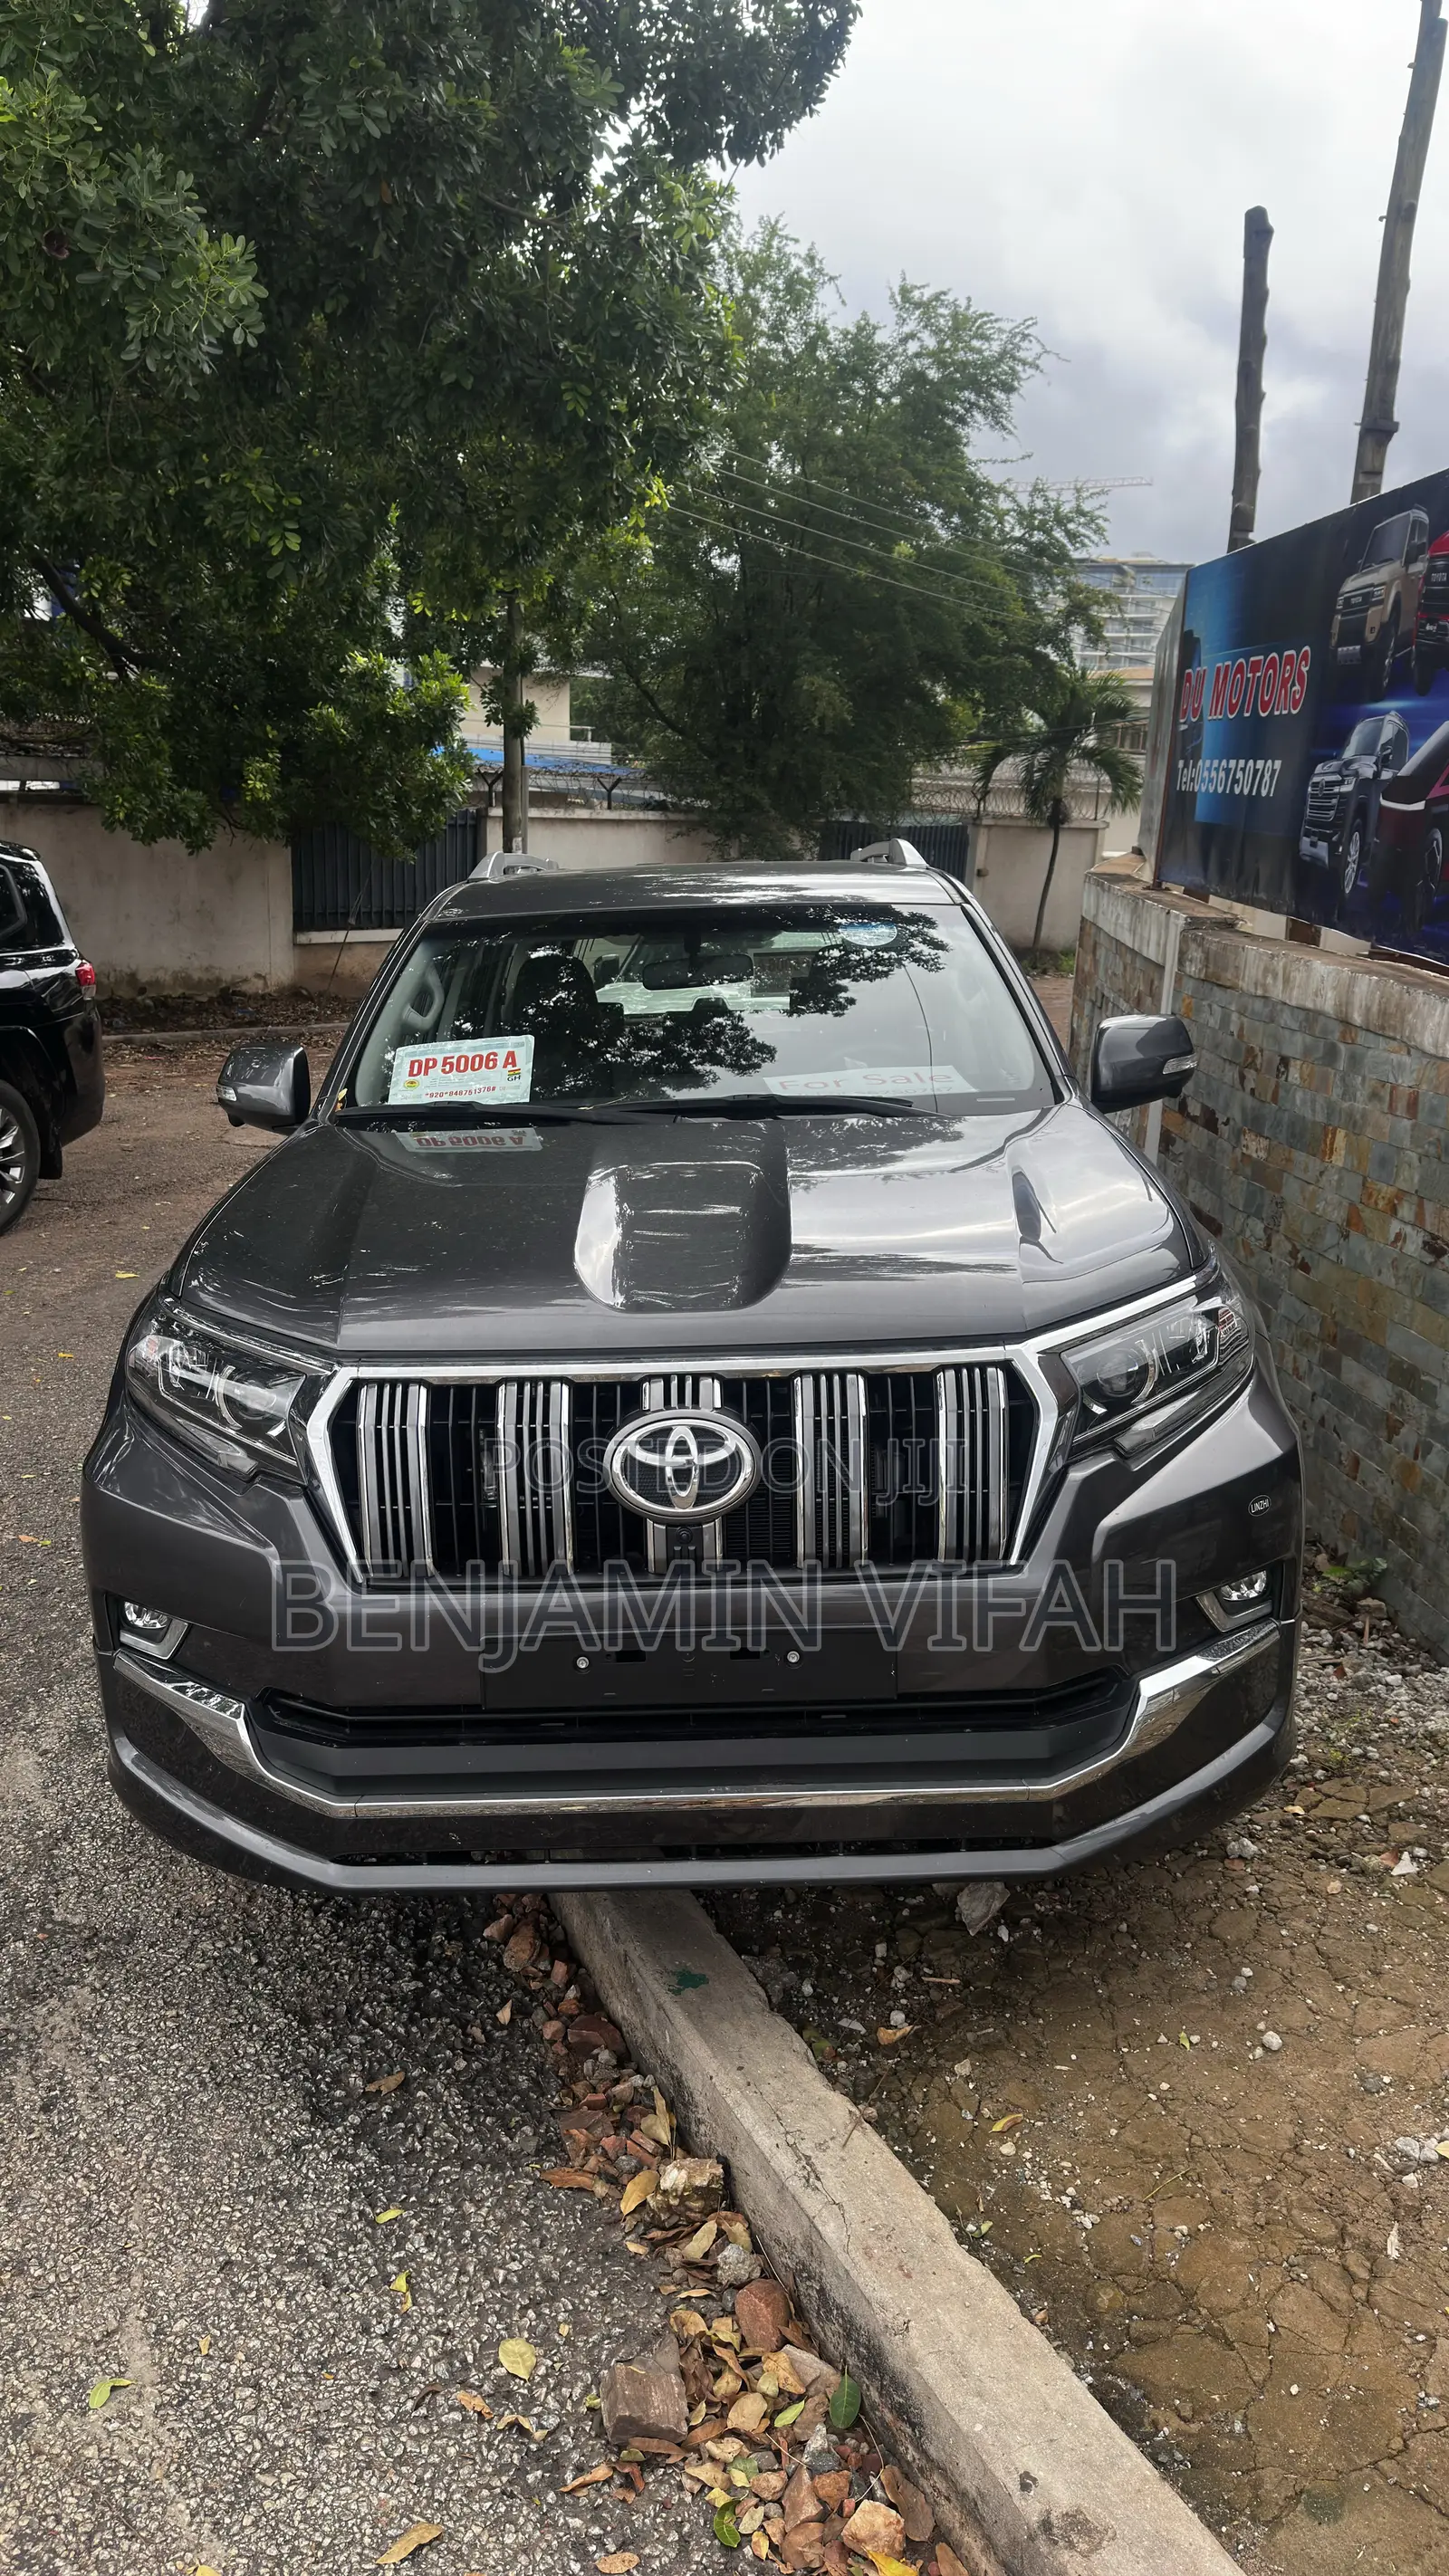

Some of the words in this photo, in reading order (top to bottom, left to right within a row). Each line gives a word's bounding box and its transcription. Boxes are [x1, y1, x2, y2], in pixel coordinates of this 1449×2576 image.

[1179, 666, 1207, 723] DU
[1208, 645, 1311, 720] MOTORS
[1176, 759, 1281, 797] Tel:0556750787
[408, 1058, 437, 1077] DP
[441, 1051, 498, 1075] 5006
[503, 1050, 517, 1069] A
[779, 1077, 848, 1090] For
[862, 1072, 955, 1086] Sale
[1251, 1499, 1270, 1513] LINZHI
